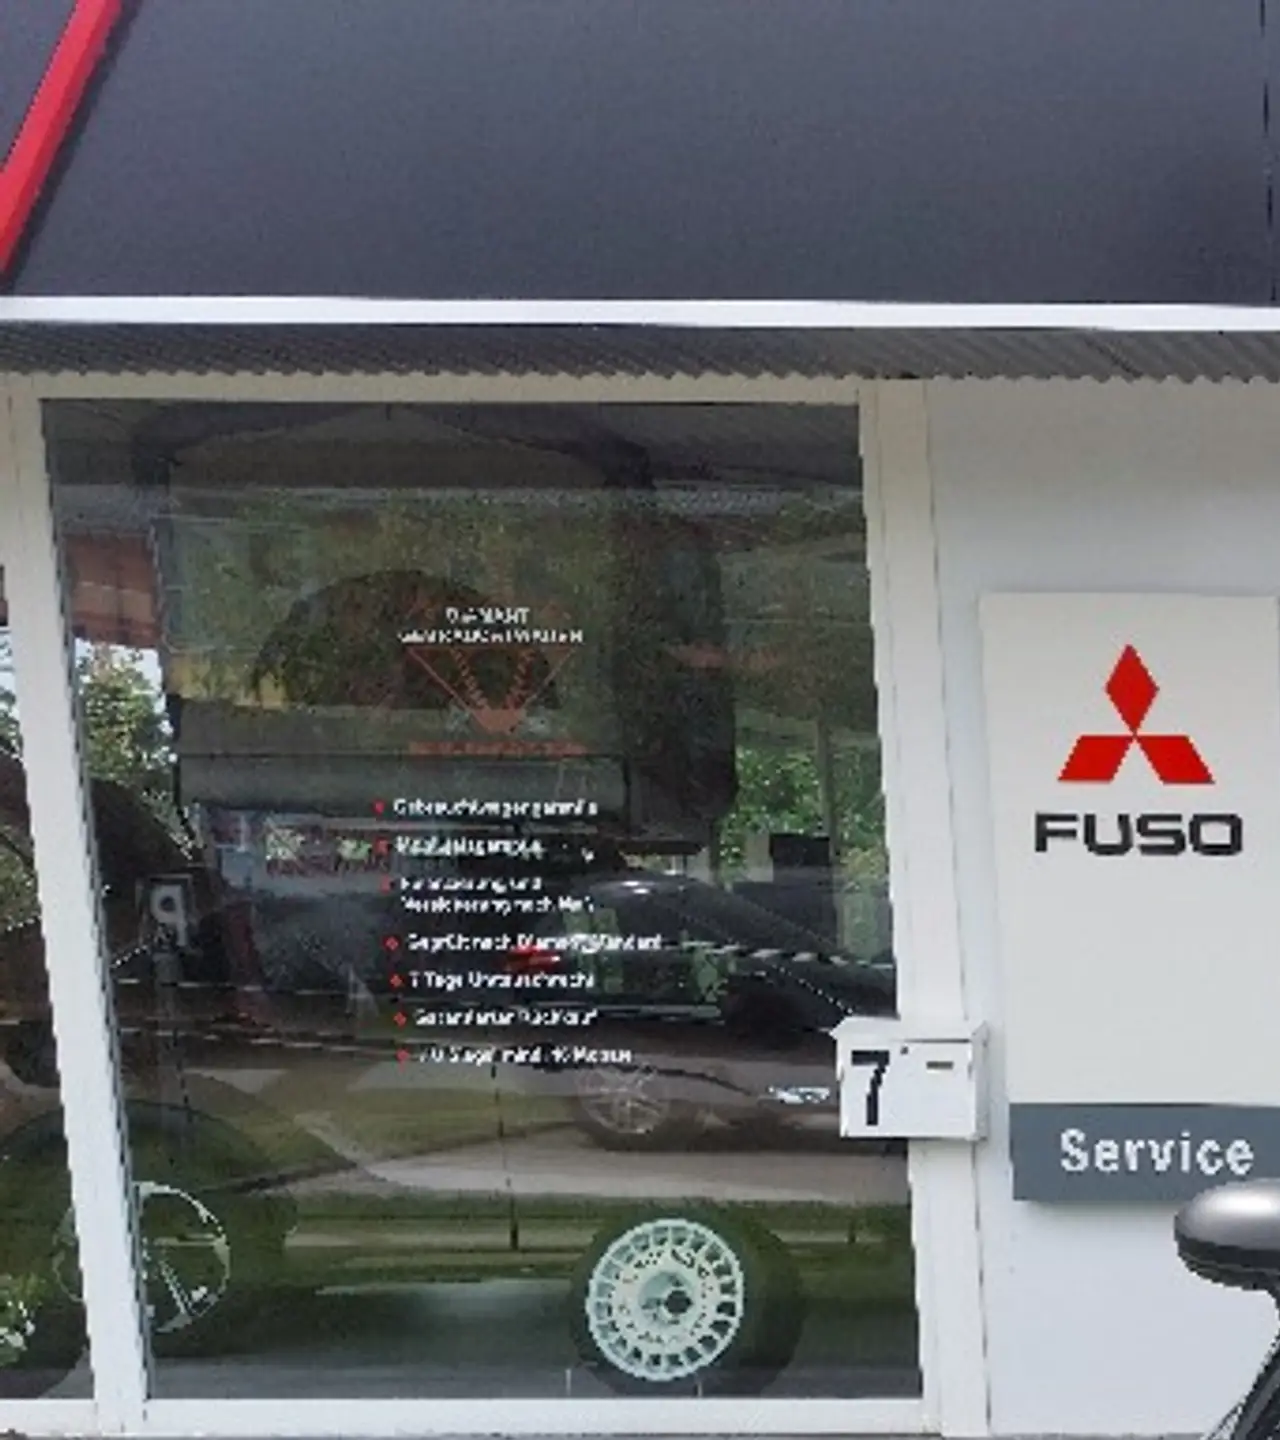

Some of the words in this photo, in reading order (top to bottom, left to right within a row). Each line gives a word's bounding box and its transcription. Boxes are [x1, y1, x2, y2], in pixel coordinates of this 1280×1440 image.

[1035, 812, 1244, 856] FUSO
[851, 1049, 891, 1127] 7
[1060, 1127, 1256, 1176] Service
